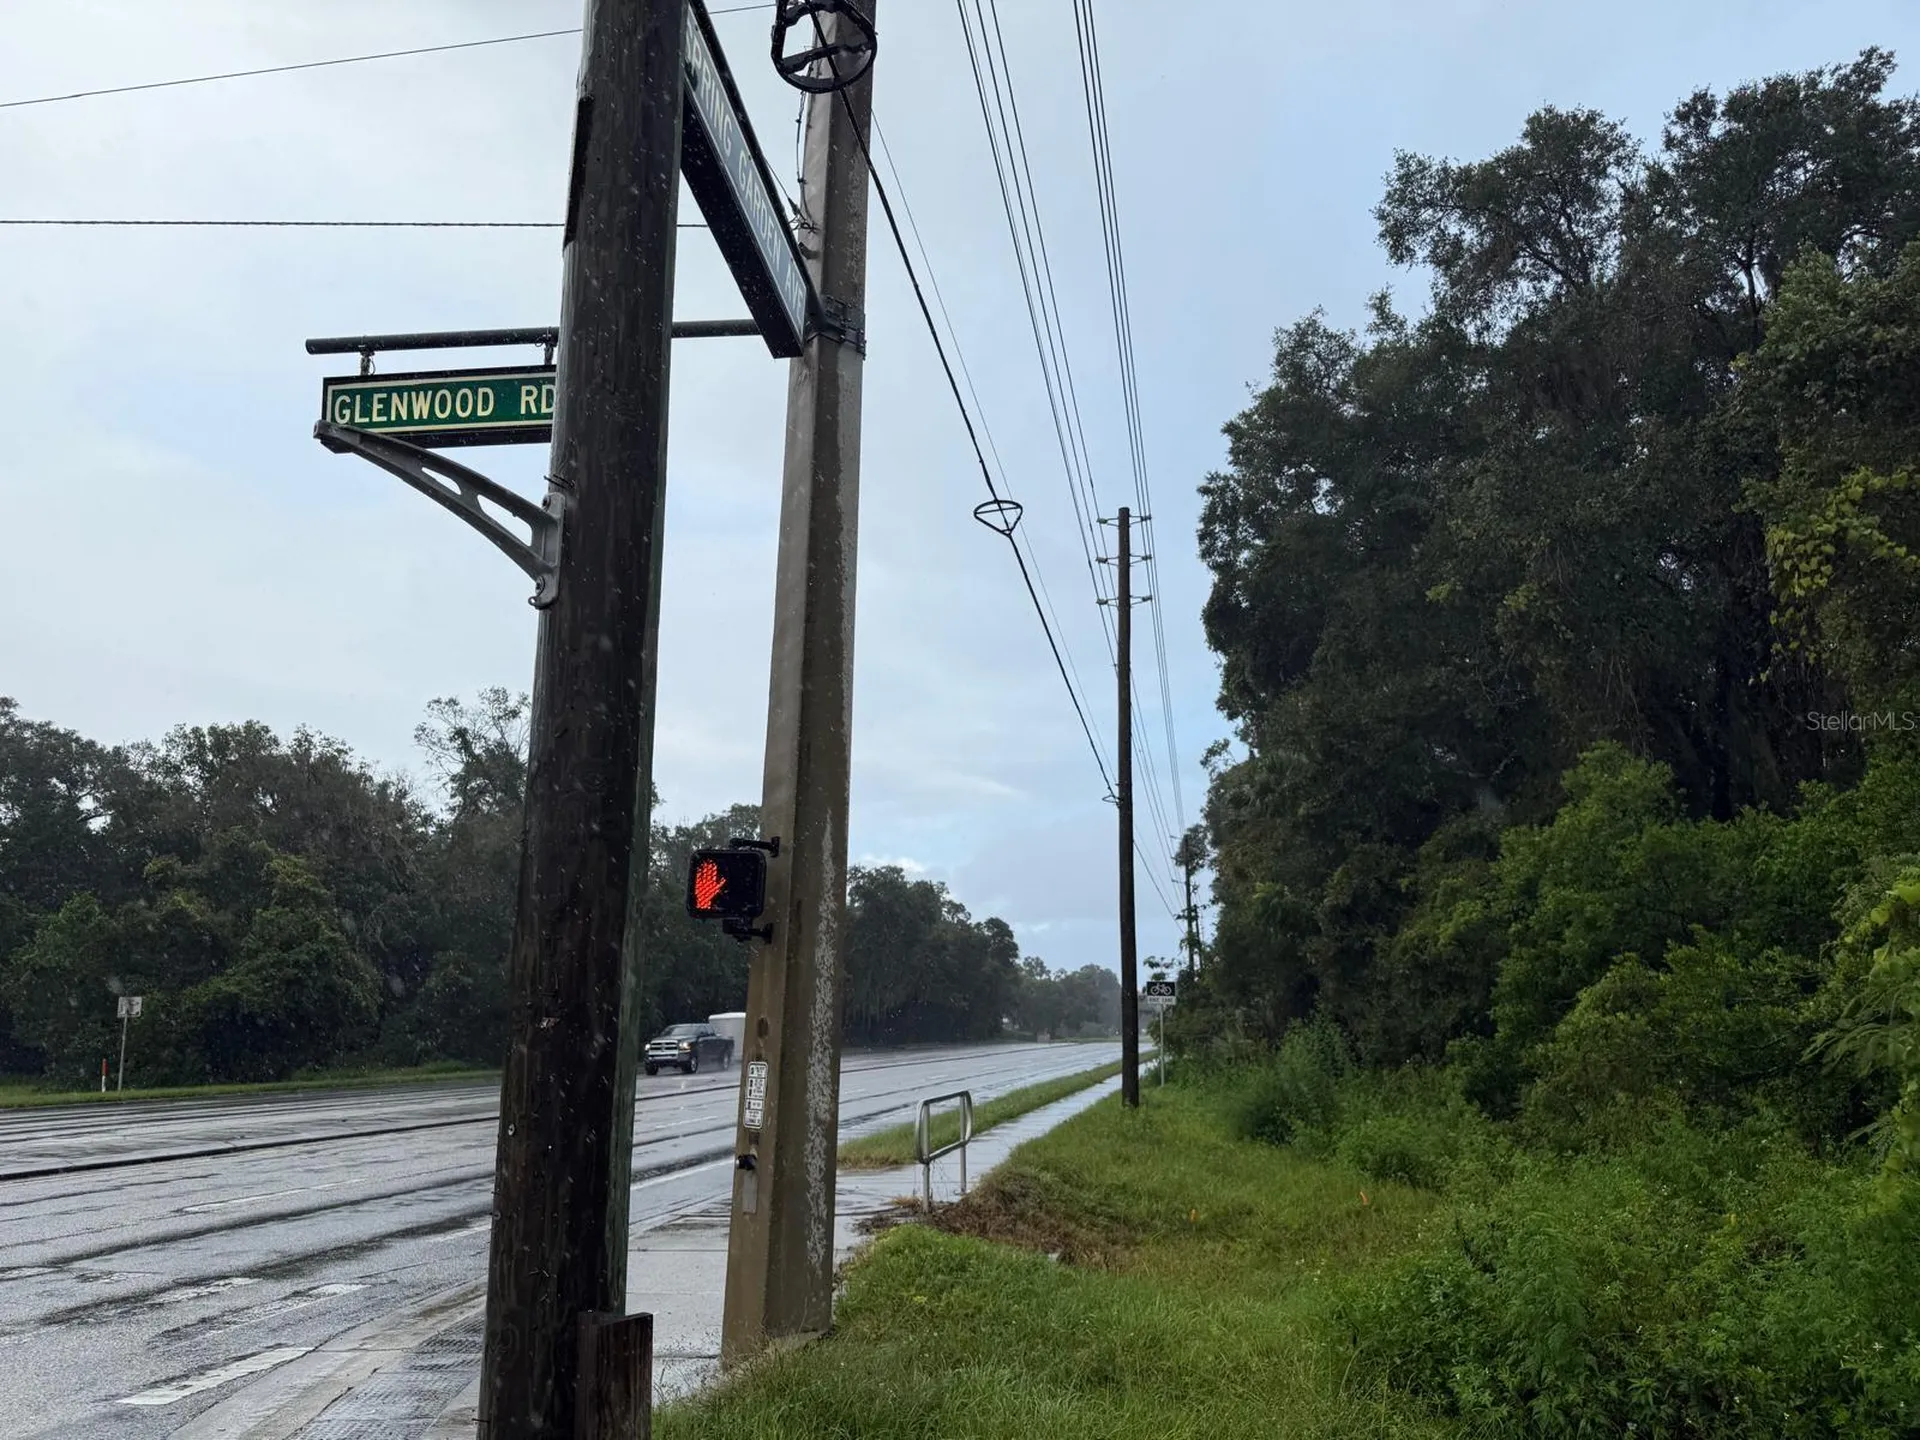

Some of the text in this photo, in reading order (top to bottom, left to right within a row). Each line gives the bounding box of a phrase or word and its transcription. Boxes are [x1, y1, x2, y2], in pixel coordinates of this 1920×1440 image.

[738, 152, 782, 272] GARDEN
[334, 385, 556, 424] GLENWOOD RD
